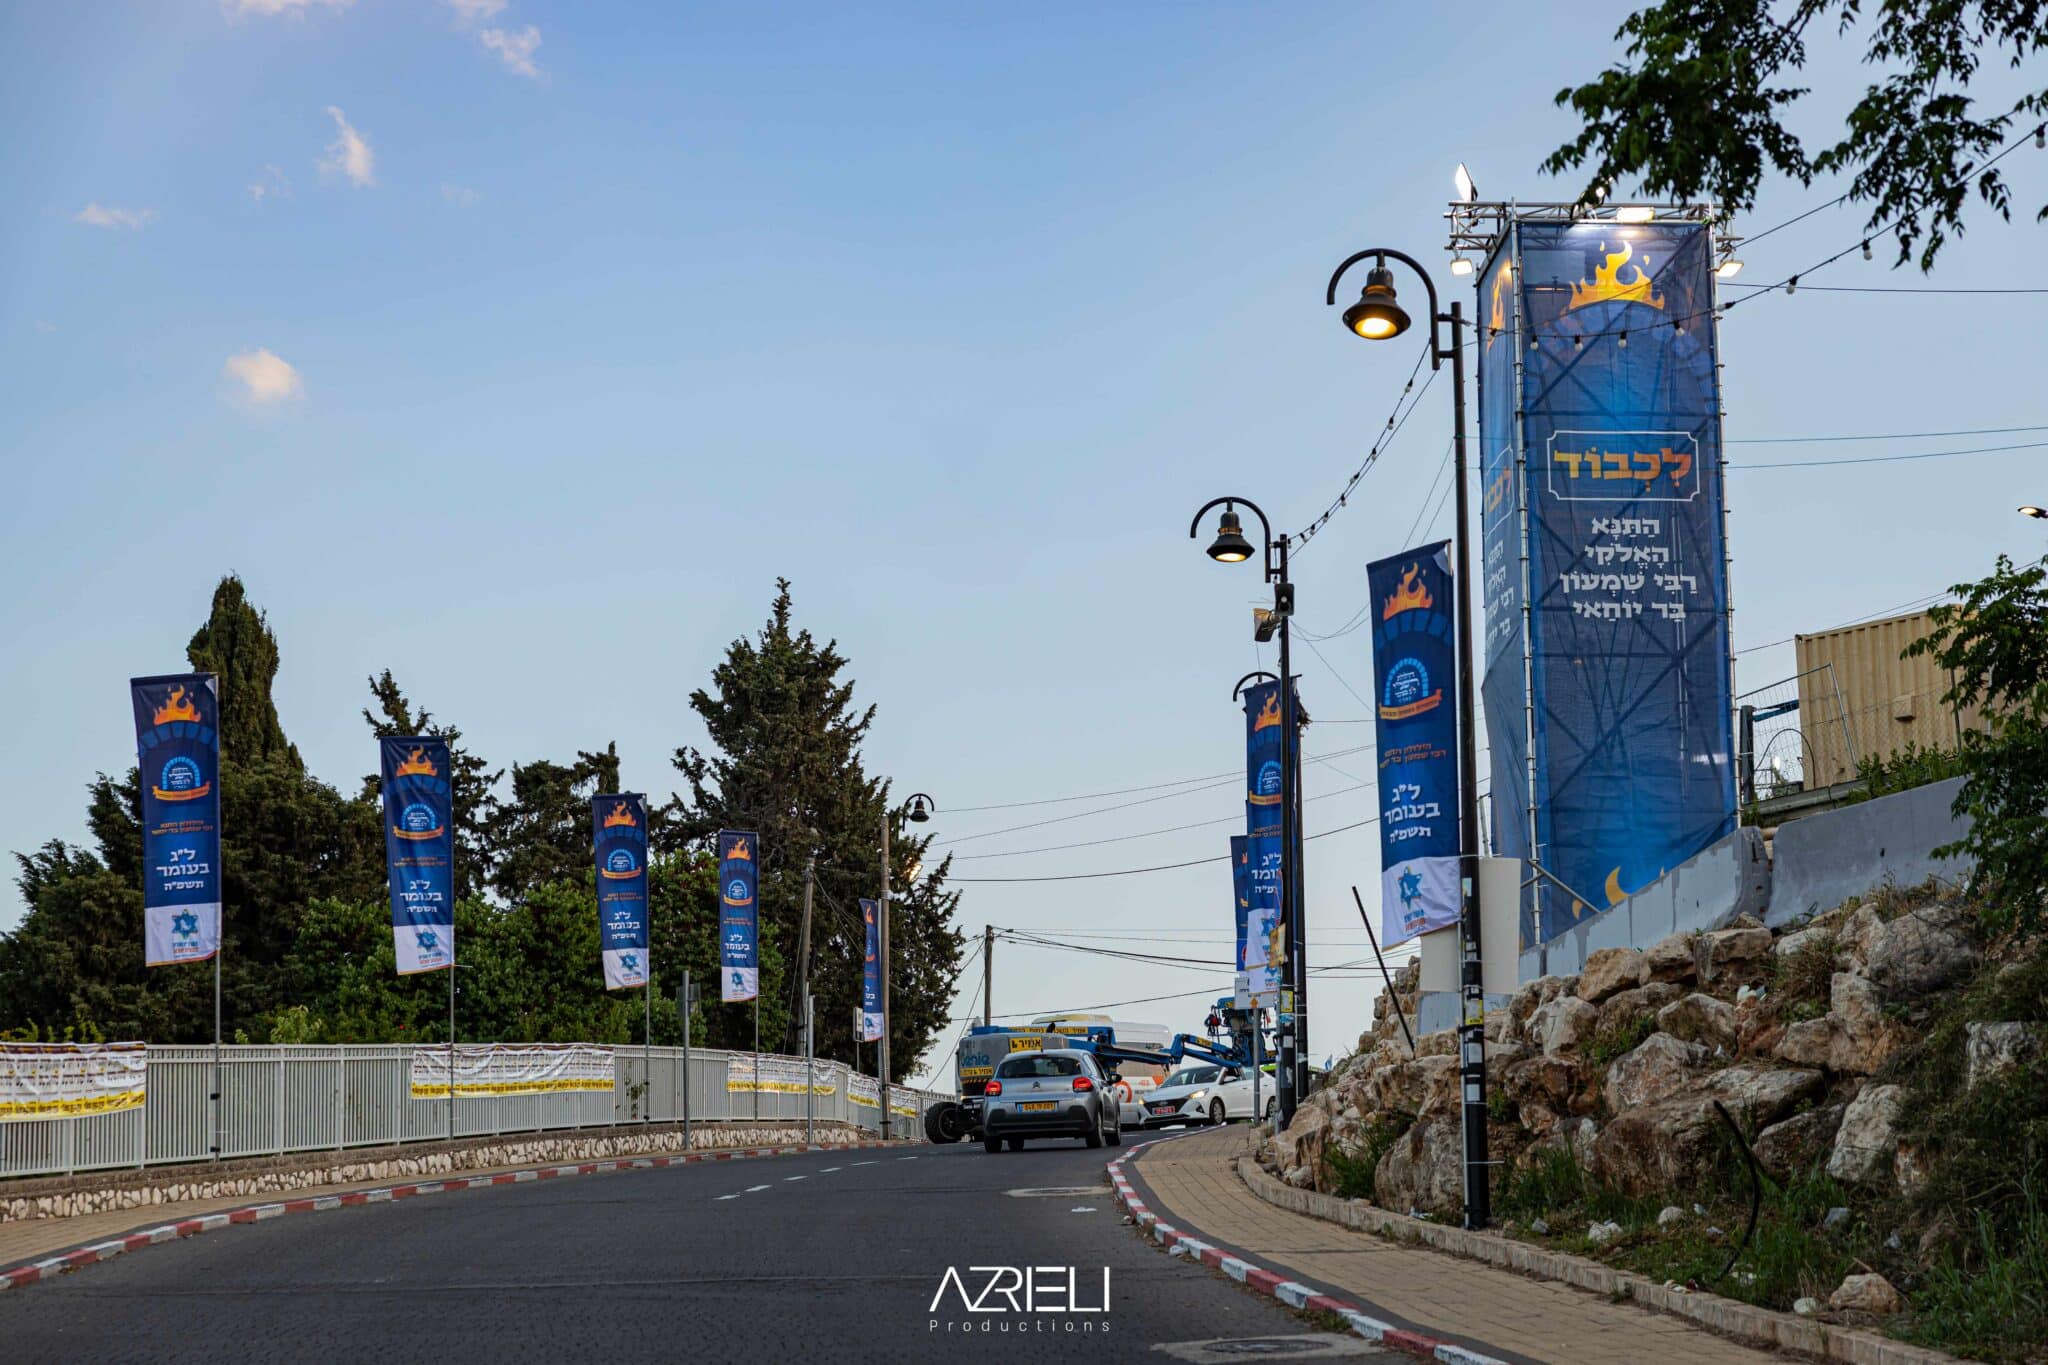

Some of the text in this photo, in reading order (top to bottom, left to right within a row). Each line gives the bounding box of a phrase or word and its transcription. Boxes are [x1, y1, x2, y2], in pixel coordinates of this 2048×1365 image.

[1384, 802, 1441, 825] בעומר
[169, 848, 196, 863] ל"ג
[156, 862, 210, 877] בעומר
[400, 891, 443, 902] בעומר
[1018, 1039, 1042, 1048] אמיר
